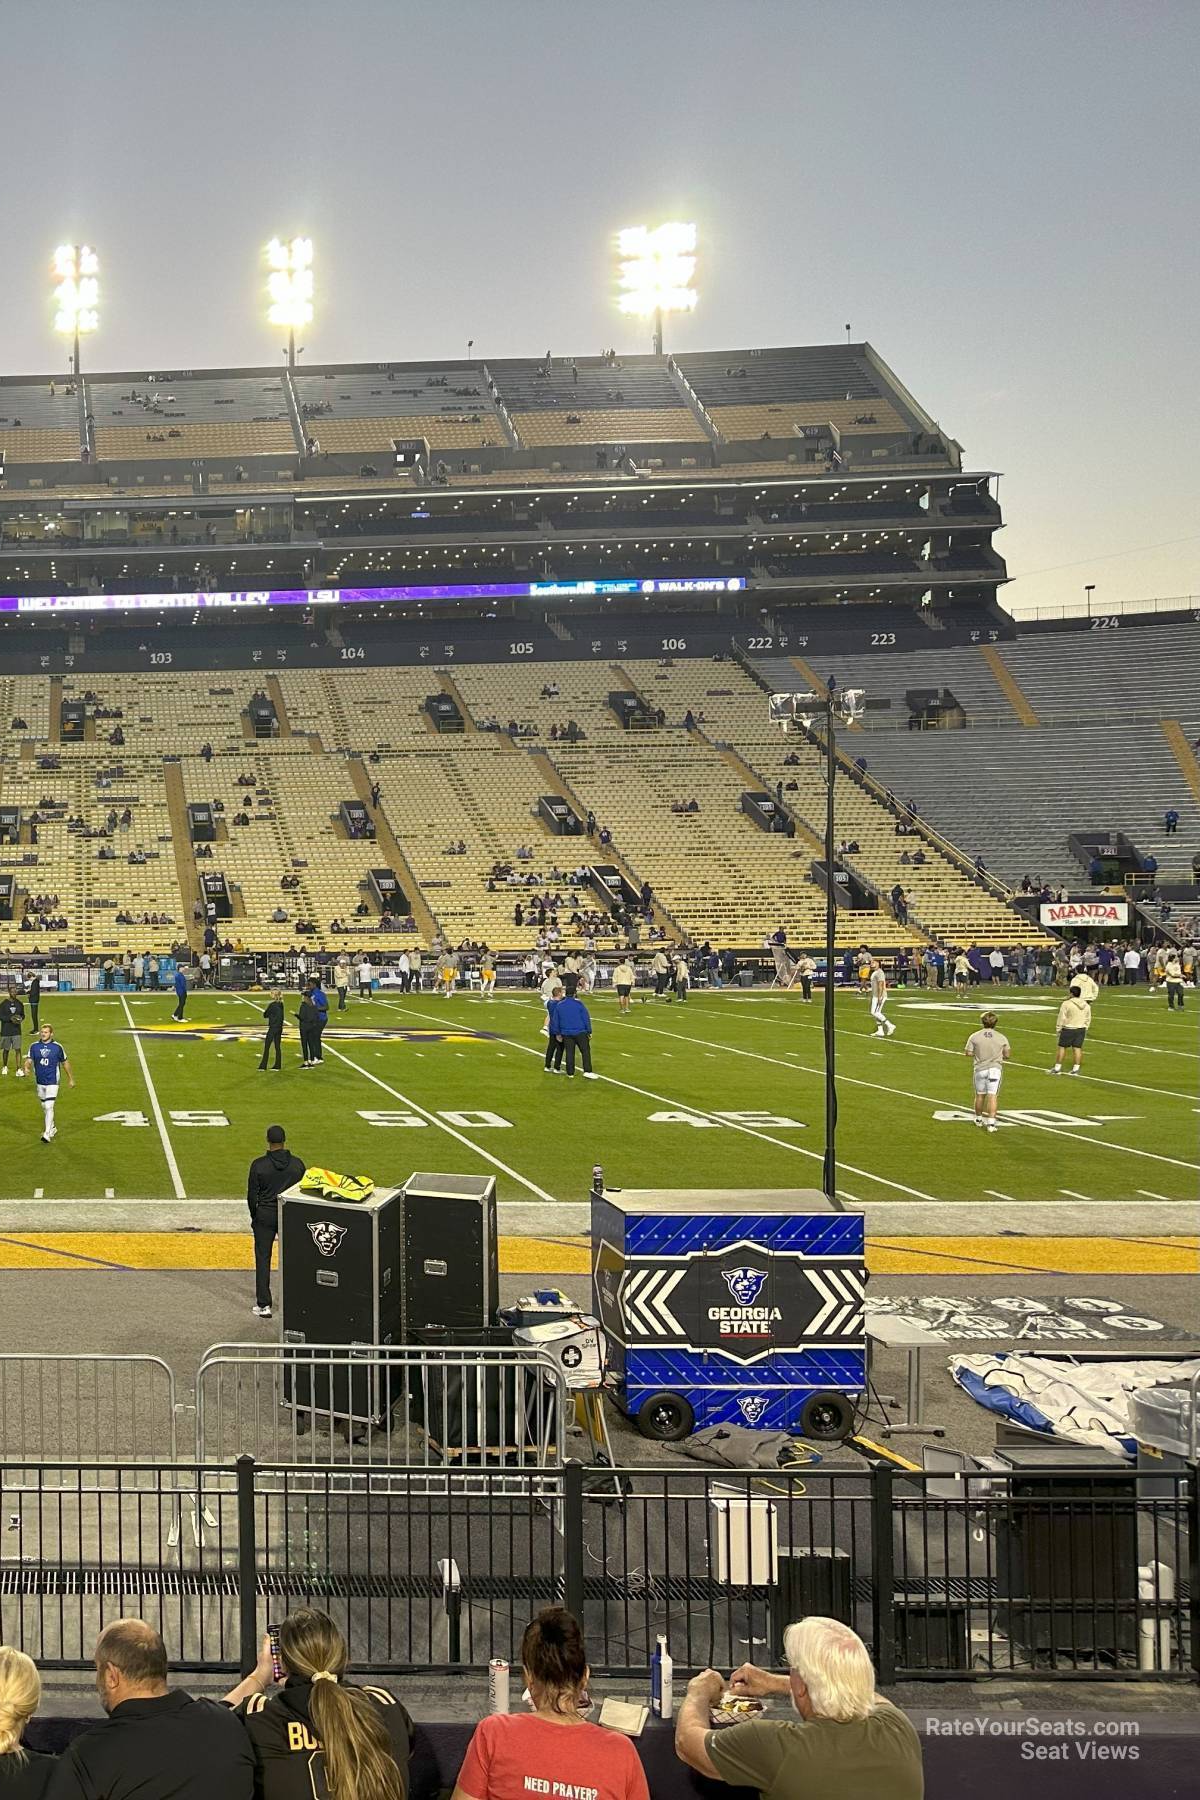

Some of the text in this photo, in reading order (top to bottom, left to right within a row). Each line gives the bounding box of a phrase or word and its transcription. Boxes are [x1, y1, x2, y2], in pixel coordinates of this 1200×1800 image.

[202, 592, 270, 606] VALLEY
[308, 591, 340, 604] LSU
[1090, 617, 1120, 629] 224
[661, 639, 687, 650] 106
[747, 637, 773, 649] 222
[871, 633, 897, 645] 223
[340, 648, 366, 659] 104
[509, 642, 534, 654] 105
[150, 653, 173, 664] 103
[1103, 847, 1115, 855] 221
[608, 879, 620, 887] 104
[836, 874, 848, 882] 105
[382, 881, 394, 889] 103
[1047, 905, 1121, 921] MANDA
[39, 1058, 49, 1066] 40
[92, 1109, 231, 1128] 45
[355, 1109, 515, 1129] 50
[647, 1110, 808, 1130] 45
[708, 1307, 783, 1320] GEORGIA
[720, 1320, 771, 1334] STATE
[524, 1775, 598, 1800] NEED PRAYER?
